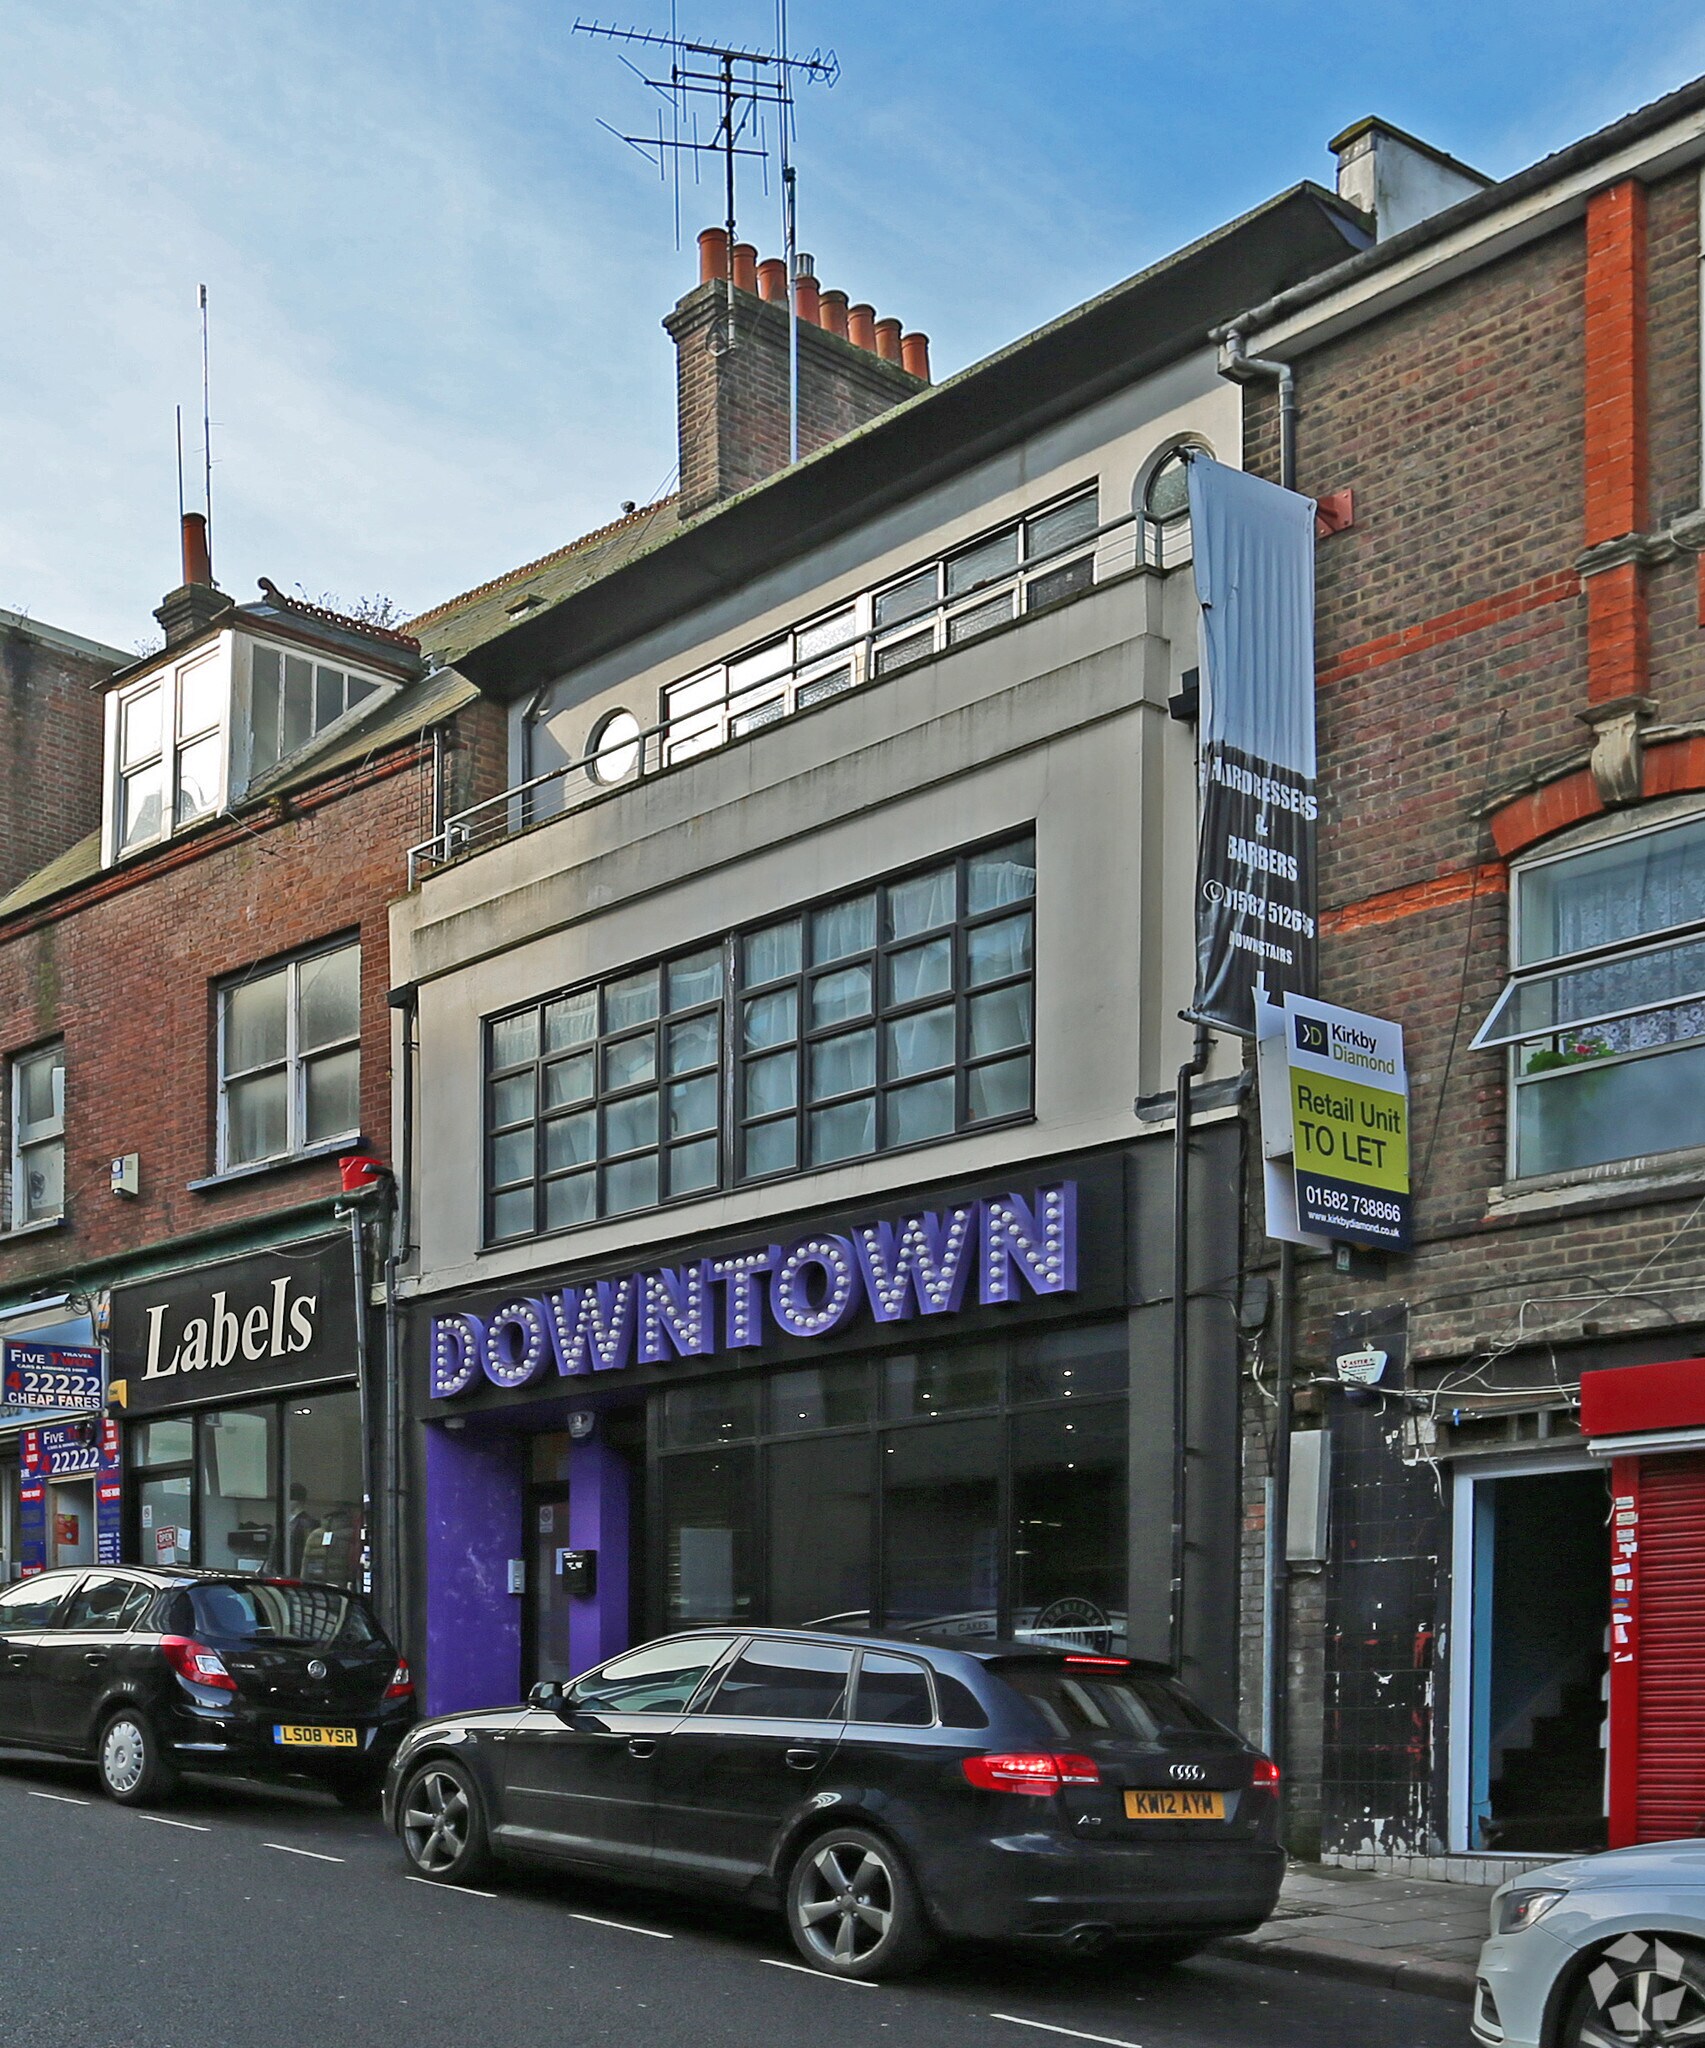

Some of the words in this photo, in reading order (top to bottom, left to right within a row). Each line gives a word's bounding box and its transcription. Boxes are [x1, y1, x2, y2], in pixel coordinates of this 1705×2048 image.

[1255, 813, 1268, 836] &
[1228, 834, 1297, 881] BARBERS
[1228, 930, 1293, 965] DOWNSTAIRS
[1331, 1023, 1377, 1054] Kirkby
[1333, 1043, 1395, 1075] Diamond
[1298, 1085, 1354, 1123] Retail
[1361, 1101, 1401, 1134] Unit
[1299, 1120, 1334, 1156] TO
[1342, 1131, 1387, 1168] LET
[1306, 1185, 1349, 1212] 01582
[1351, 1195, 1401, 1222] 738866
[1307, 1211, 1400, 1237] www.kirkbydiamond.co.uk
[430, 1180, 1077, 1399] DOWNTOWN
[141, 1276, 317, 1381] Labels
[8, 1392, 54, 1405] CHEAP
[58, 1395, 100, 1409] FARES
[283, 1727, 322, 1742] LS08
[325, 1728, 354, 1744] YSR
[1135, 1793, 1177, 1814] KW12
